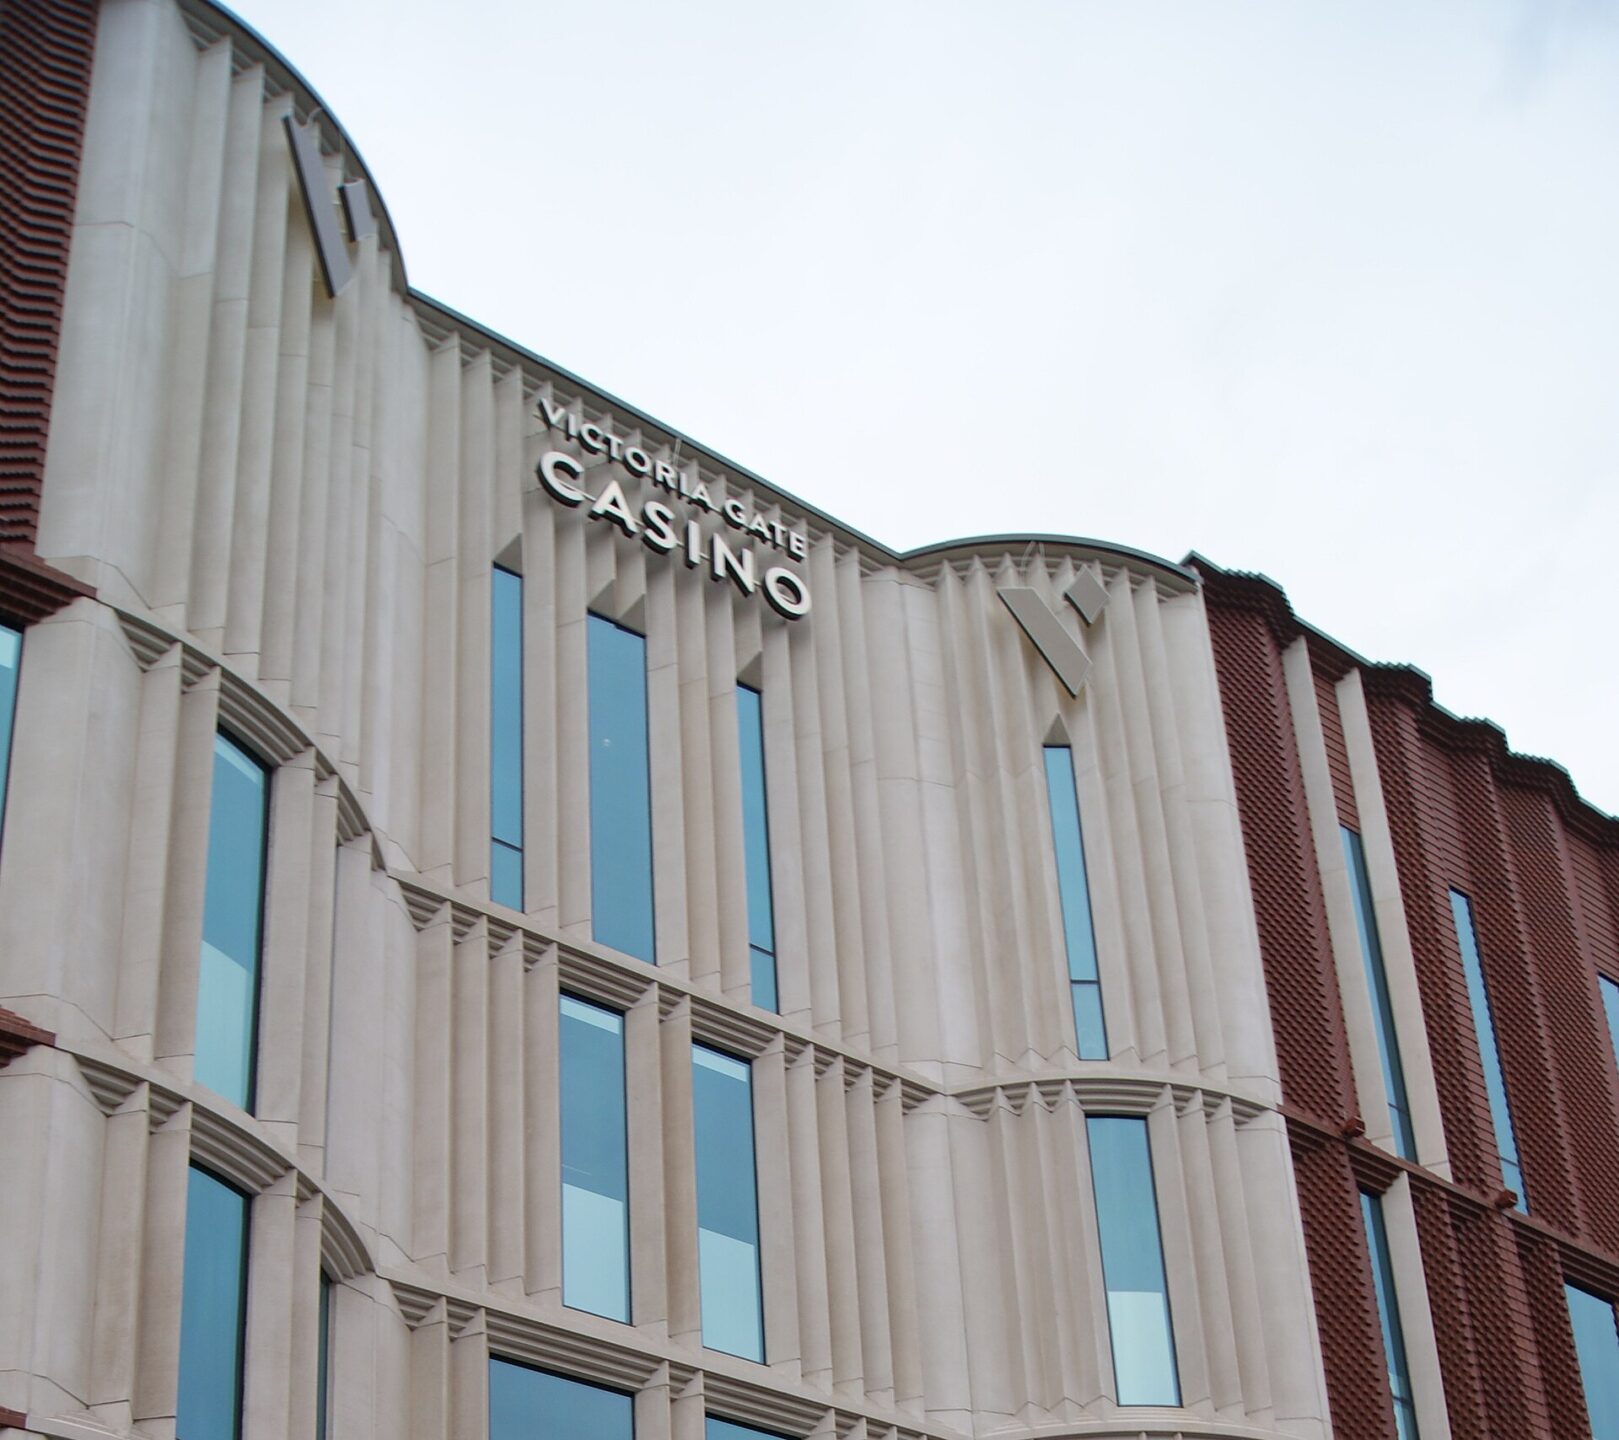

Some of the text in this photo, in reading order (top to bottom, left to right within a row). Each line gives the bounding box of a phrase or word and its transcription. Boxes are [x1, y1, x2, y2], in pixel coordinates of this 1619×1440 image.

[536, 451, 812, 620] CASINO
[537, 398, 807, 562] VICTORIA GATE
